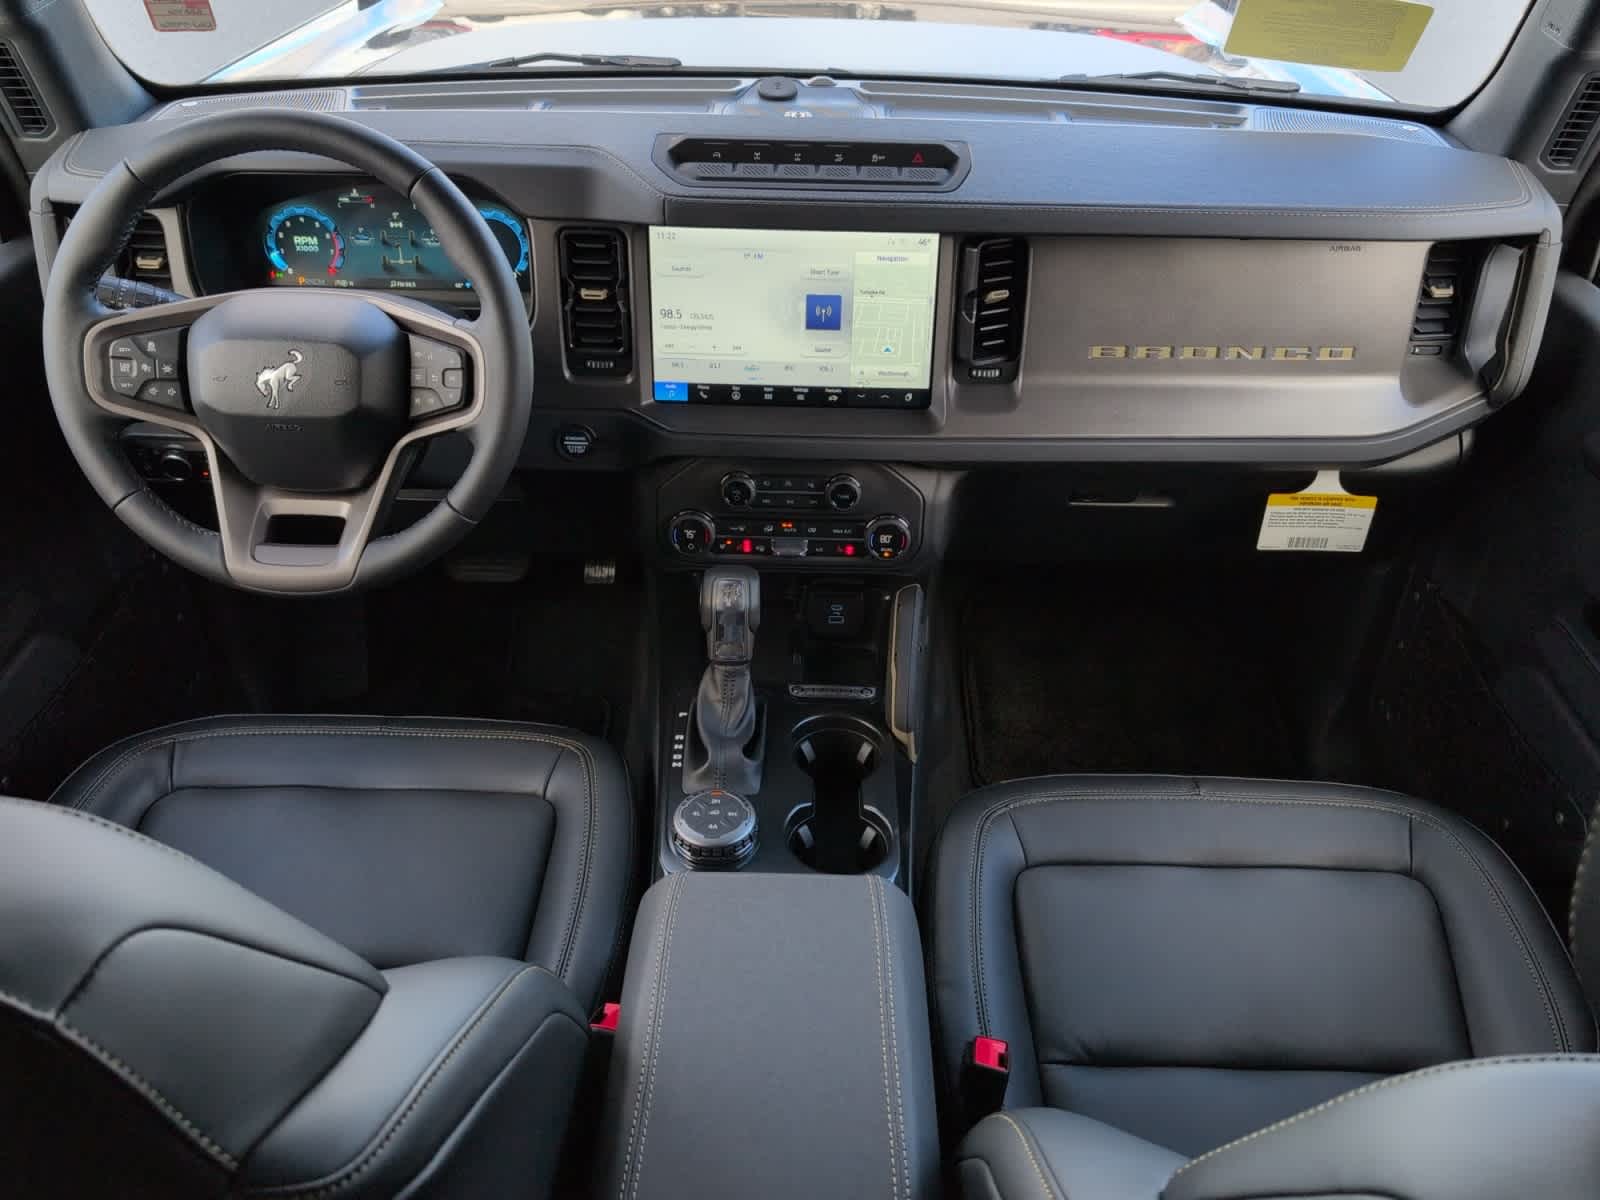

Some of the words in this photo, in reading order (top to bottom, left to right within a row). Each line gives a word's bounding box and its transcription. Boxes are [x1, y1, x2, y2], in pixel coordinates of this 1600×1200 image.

[293, 235, 319, 246] RPM
[656, 231, 677, 240] 11:22
[877, 255, 909, 263] Navigation
[659, 308, 682, 320] 98.5
[1088, 345, 1356, 361] BRONCO
